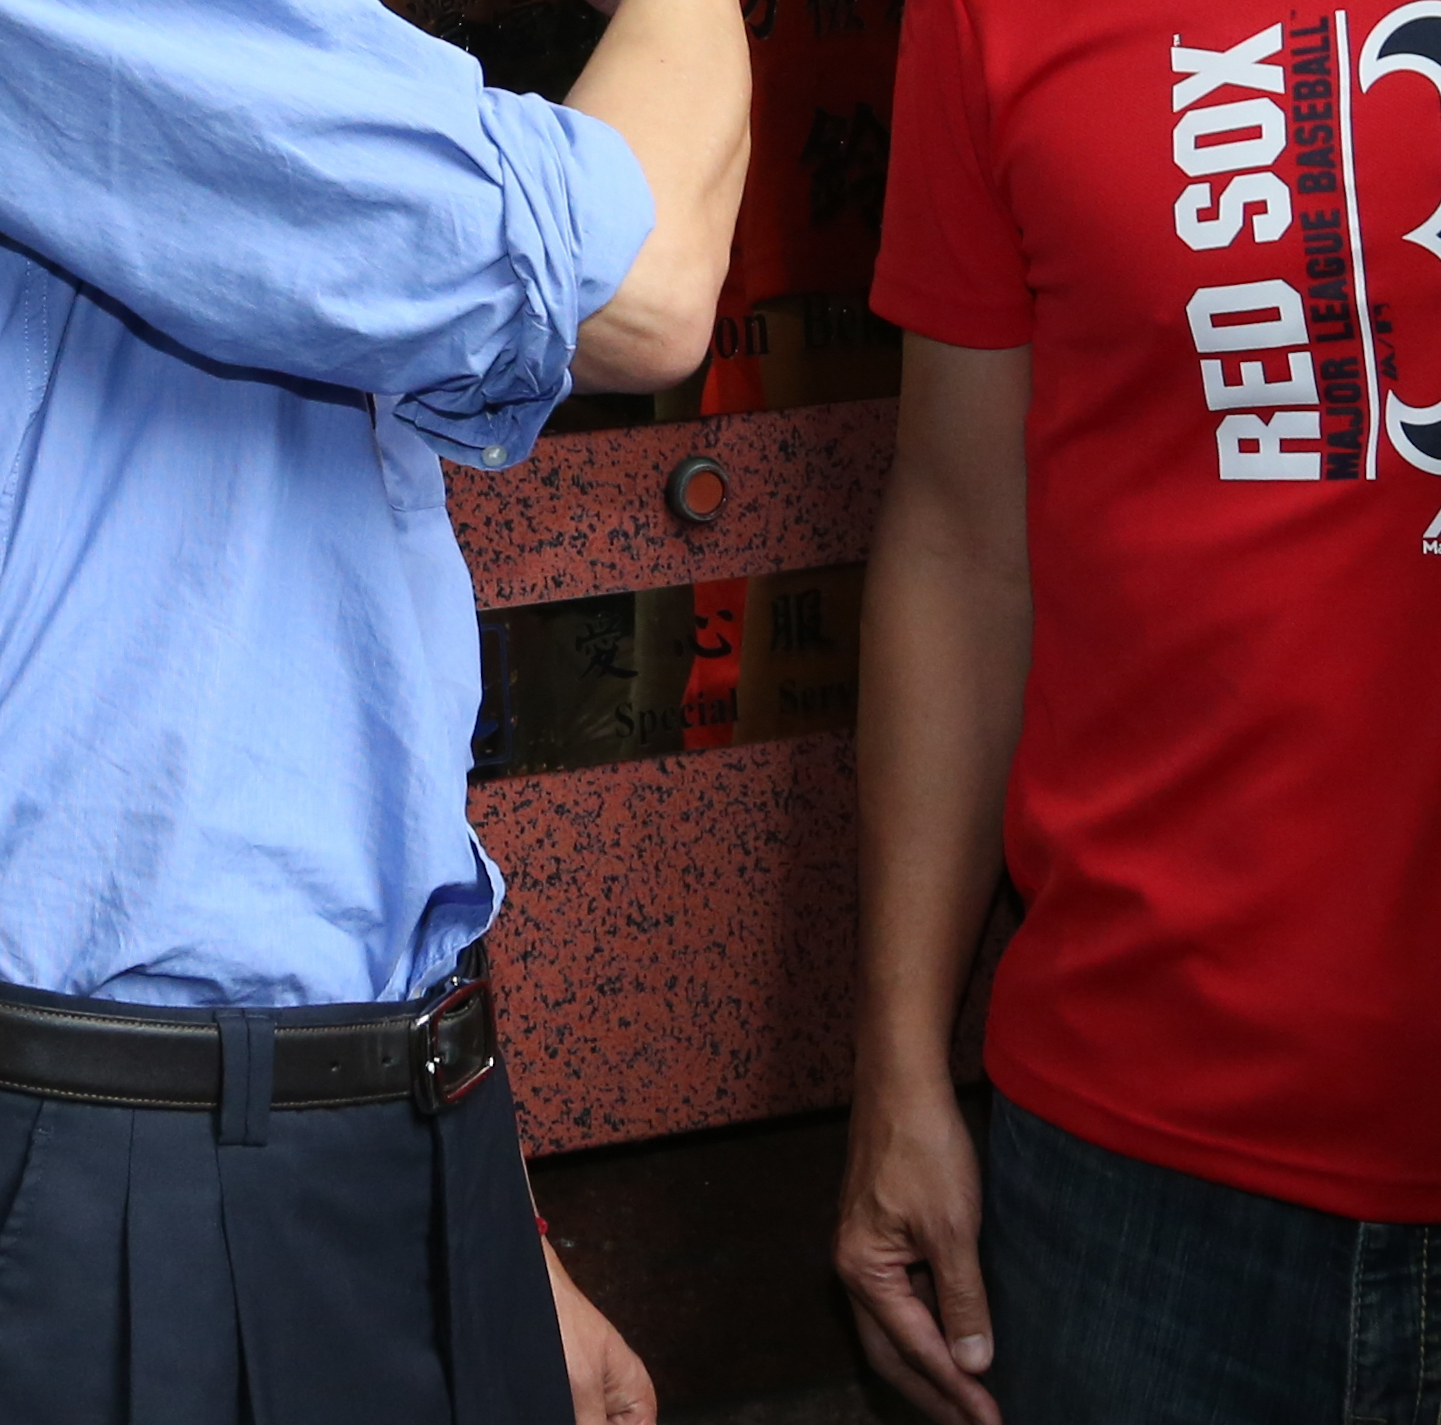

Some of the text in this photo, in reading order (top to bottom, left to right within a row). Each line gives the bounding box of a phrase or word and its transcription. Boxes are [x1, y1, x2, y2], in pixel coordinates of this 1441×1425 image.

[1171, 22, 1323, 481] RED SOX
[1290, 15, 1365, 481] MAJOR LEAGUE BASEBALL
[614, 676, 856, 746] Special Serv
